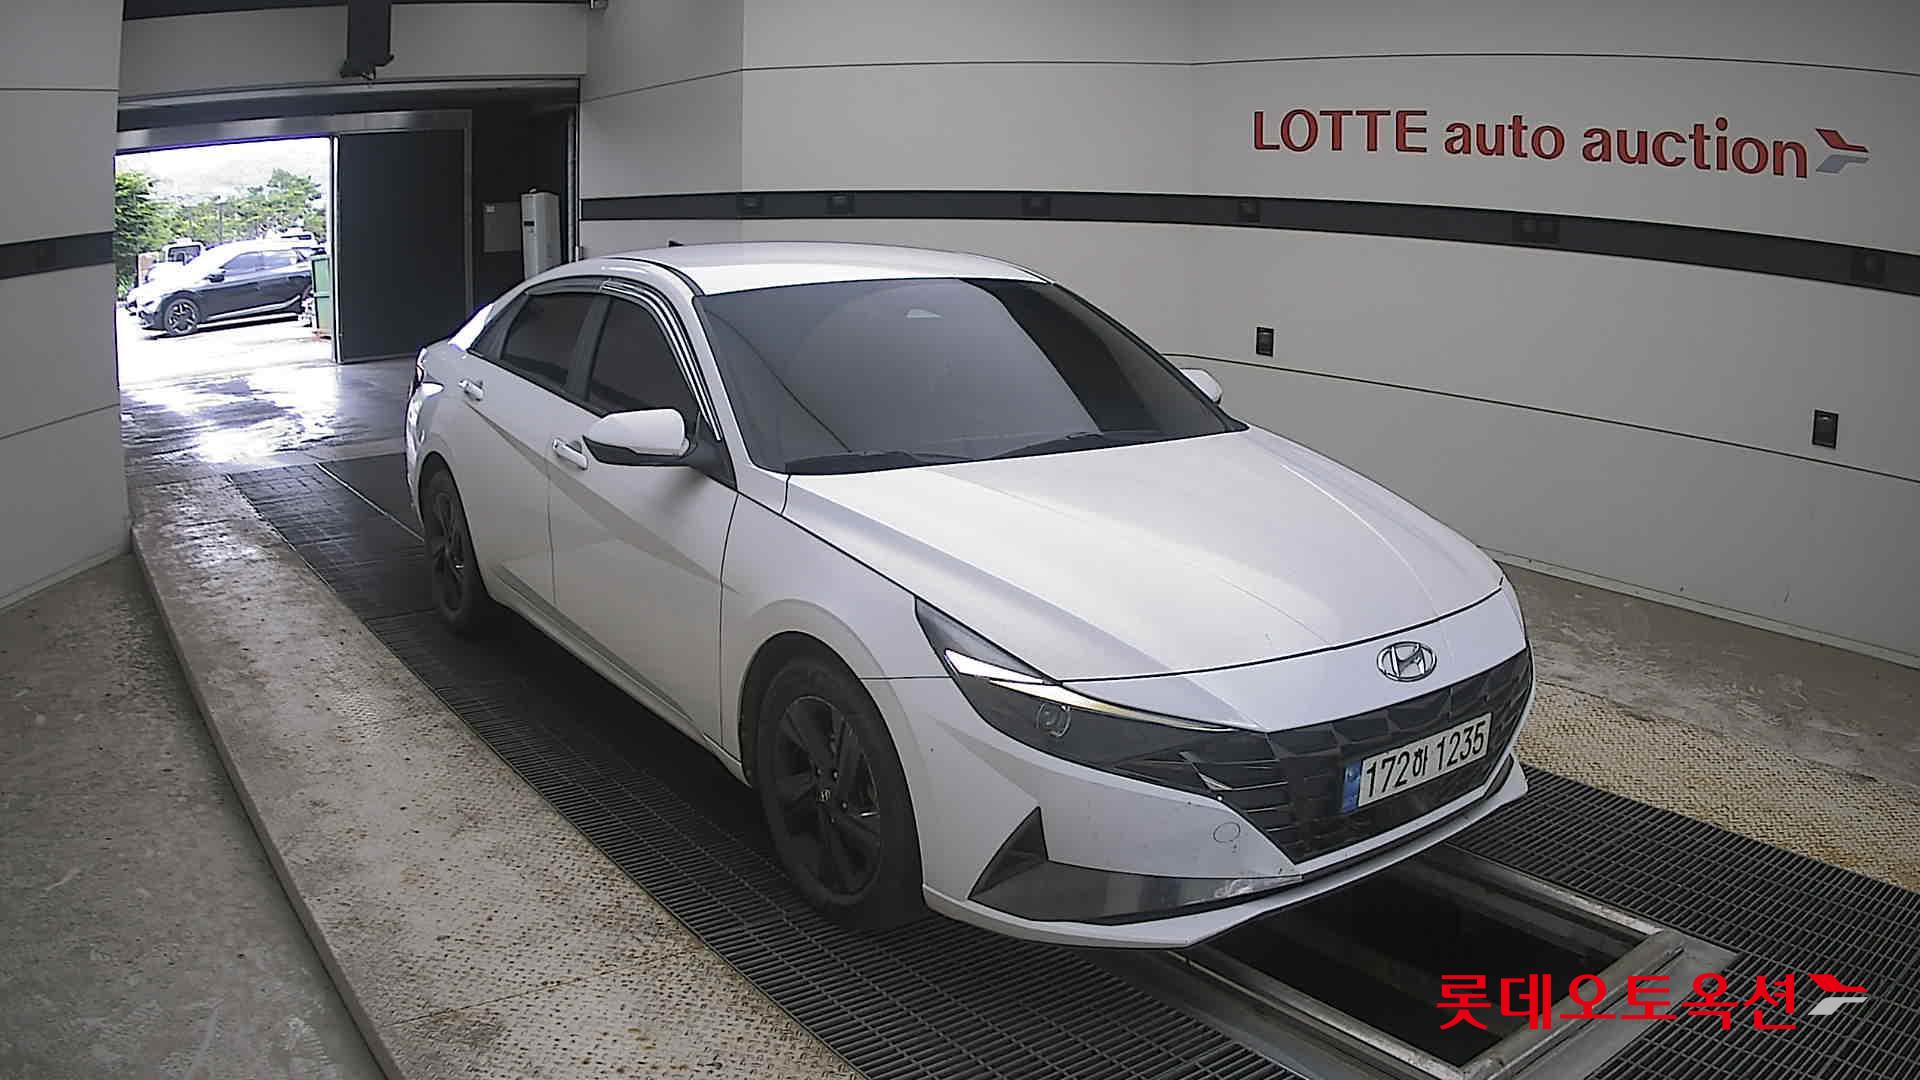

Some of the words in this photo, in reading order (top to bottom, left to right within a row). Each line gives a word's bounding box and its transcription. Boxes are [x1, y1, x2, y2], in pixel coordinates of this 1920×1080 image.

[1252, 109, 1429, 153] LOTTE
[1444, 114, 1565, 160] auto
[1581, 117, 1808, 178] auction
[1367, 745, 1428, 797] 172하
[1437, 721, 1486, 770] 1235
